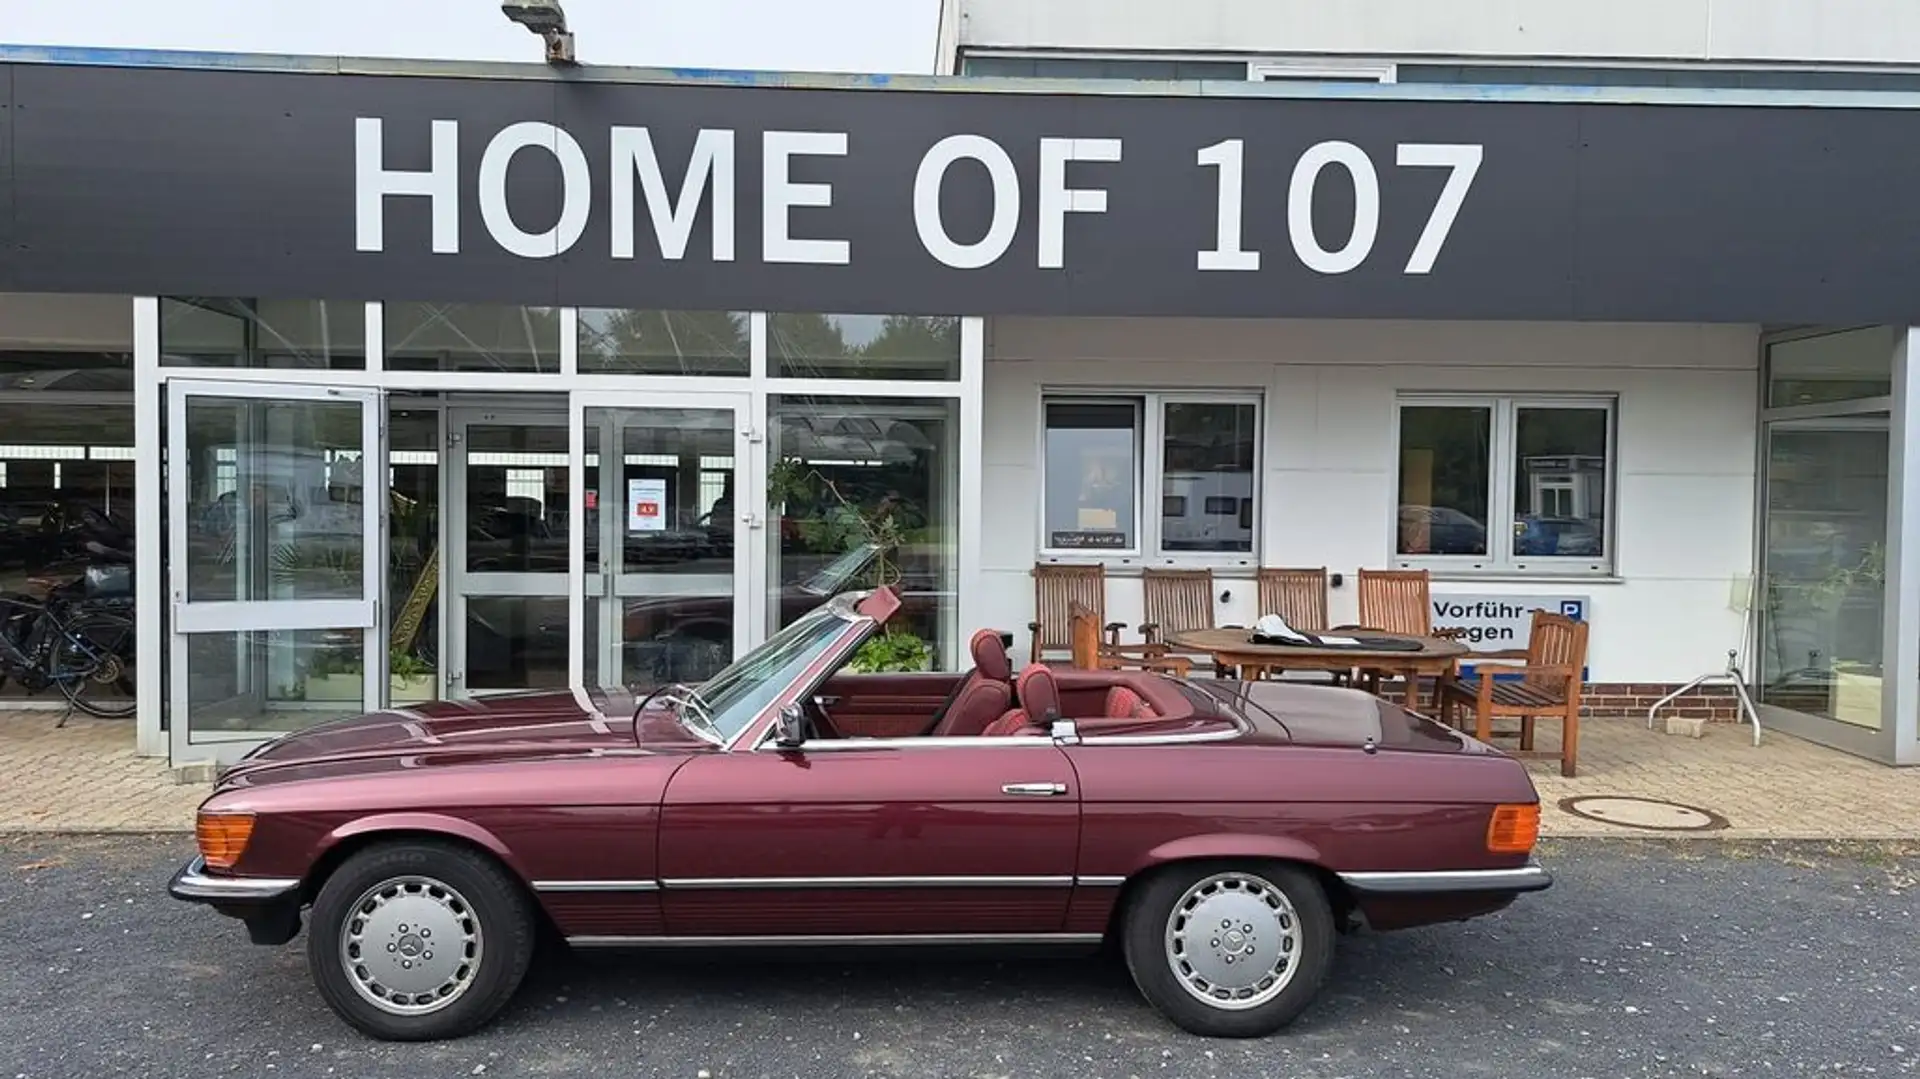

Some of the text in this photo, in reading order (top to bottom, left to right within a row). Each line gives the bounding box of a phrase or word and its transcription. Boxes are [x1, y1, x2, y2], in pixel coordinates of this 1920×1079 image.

[356, 118, 1483, 274] HOME OF 107
[1433, 601, 1536, 618] Vorführ-
[1563, 603, 1578, 616] P
